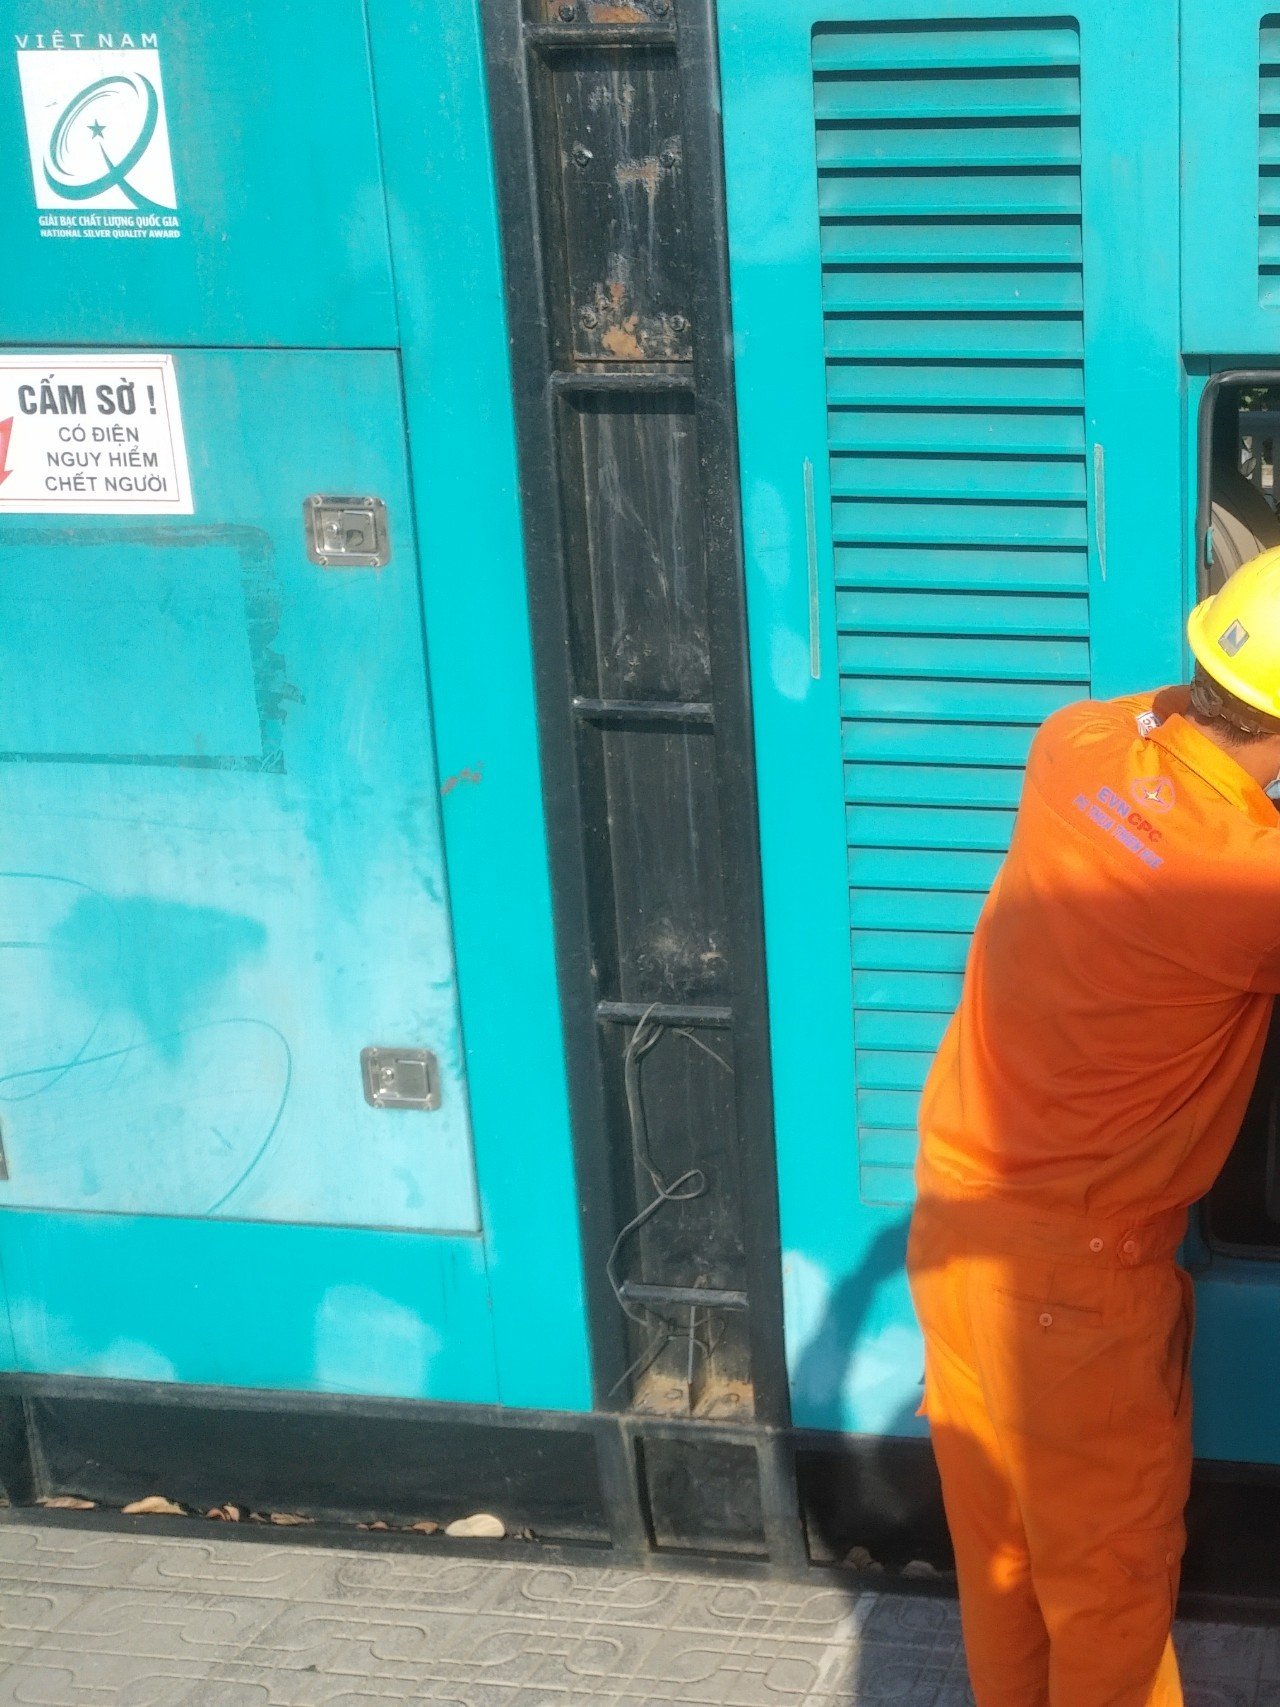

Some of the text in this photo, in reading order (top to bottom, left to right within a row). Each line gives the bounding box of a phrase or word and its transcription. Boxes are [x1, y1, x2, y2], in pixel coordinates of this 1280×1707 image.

[15, 29, 158, 51] VIỆT NAM
[60, 216, 77, 228] BẠC
[136, 213, 160, 228] QUỐC
[162, 216, 179, 226] GIA
[41, 229, 181, 239] NATIONAL SILVER QUALITY AWARD
[18, 374, 86, 415] CẤM
[96, 378, 136, 415] SỜ
[58, 424, 139, 446] CÓ ĐIỆN
[47, 445, 158, 468] NGUY HIỂM
[45, 472, 167, 492] CHẾT NGƯỜI
